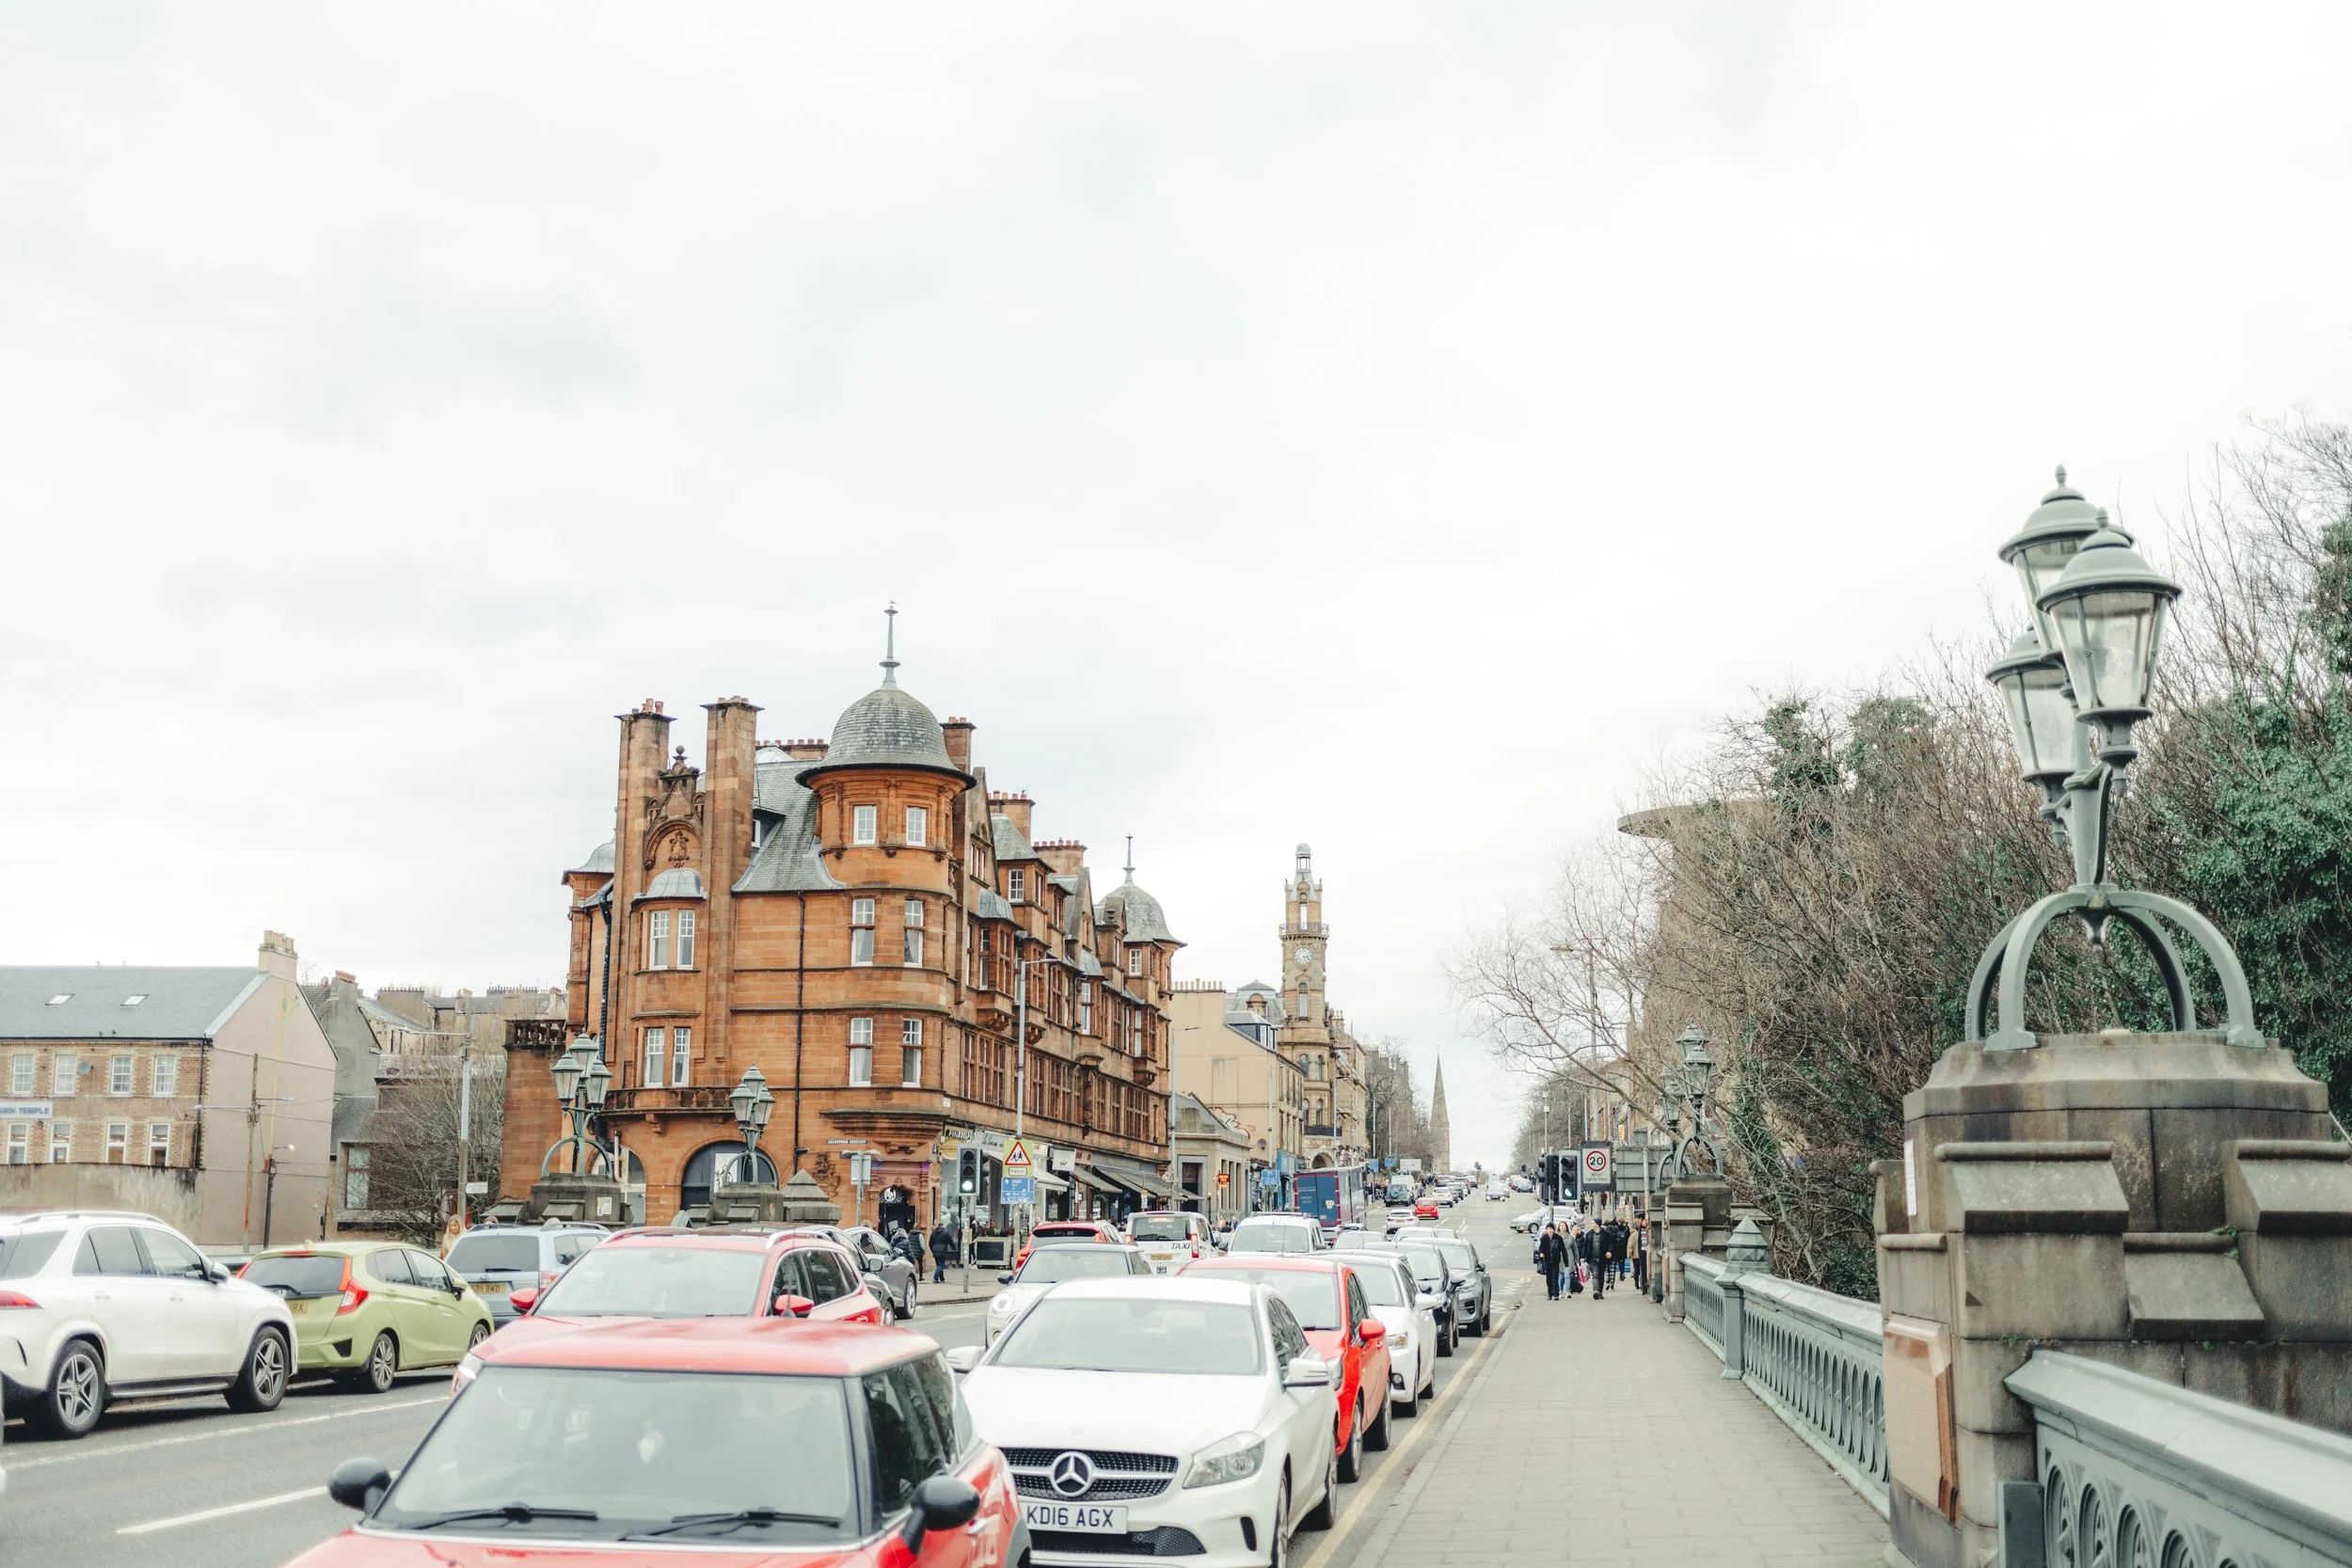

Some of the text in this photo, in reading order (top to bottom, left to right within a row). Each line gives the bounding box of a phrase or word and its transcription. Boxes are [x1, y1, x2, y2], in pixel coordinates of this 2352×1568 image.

[19, 1106, 50, 1115] TEMPLE
[1589, 1156, 1604, 1165] 20
[1026, 1506, 1114, 1528] KD16 AGX
